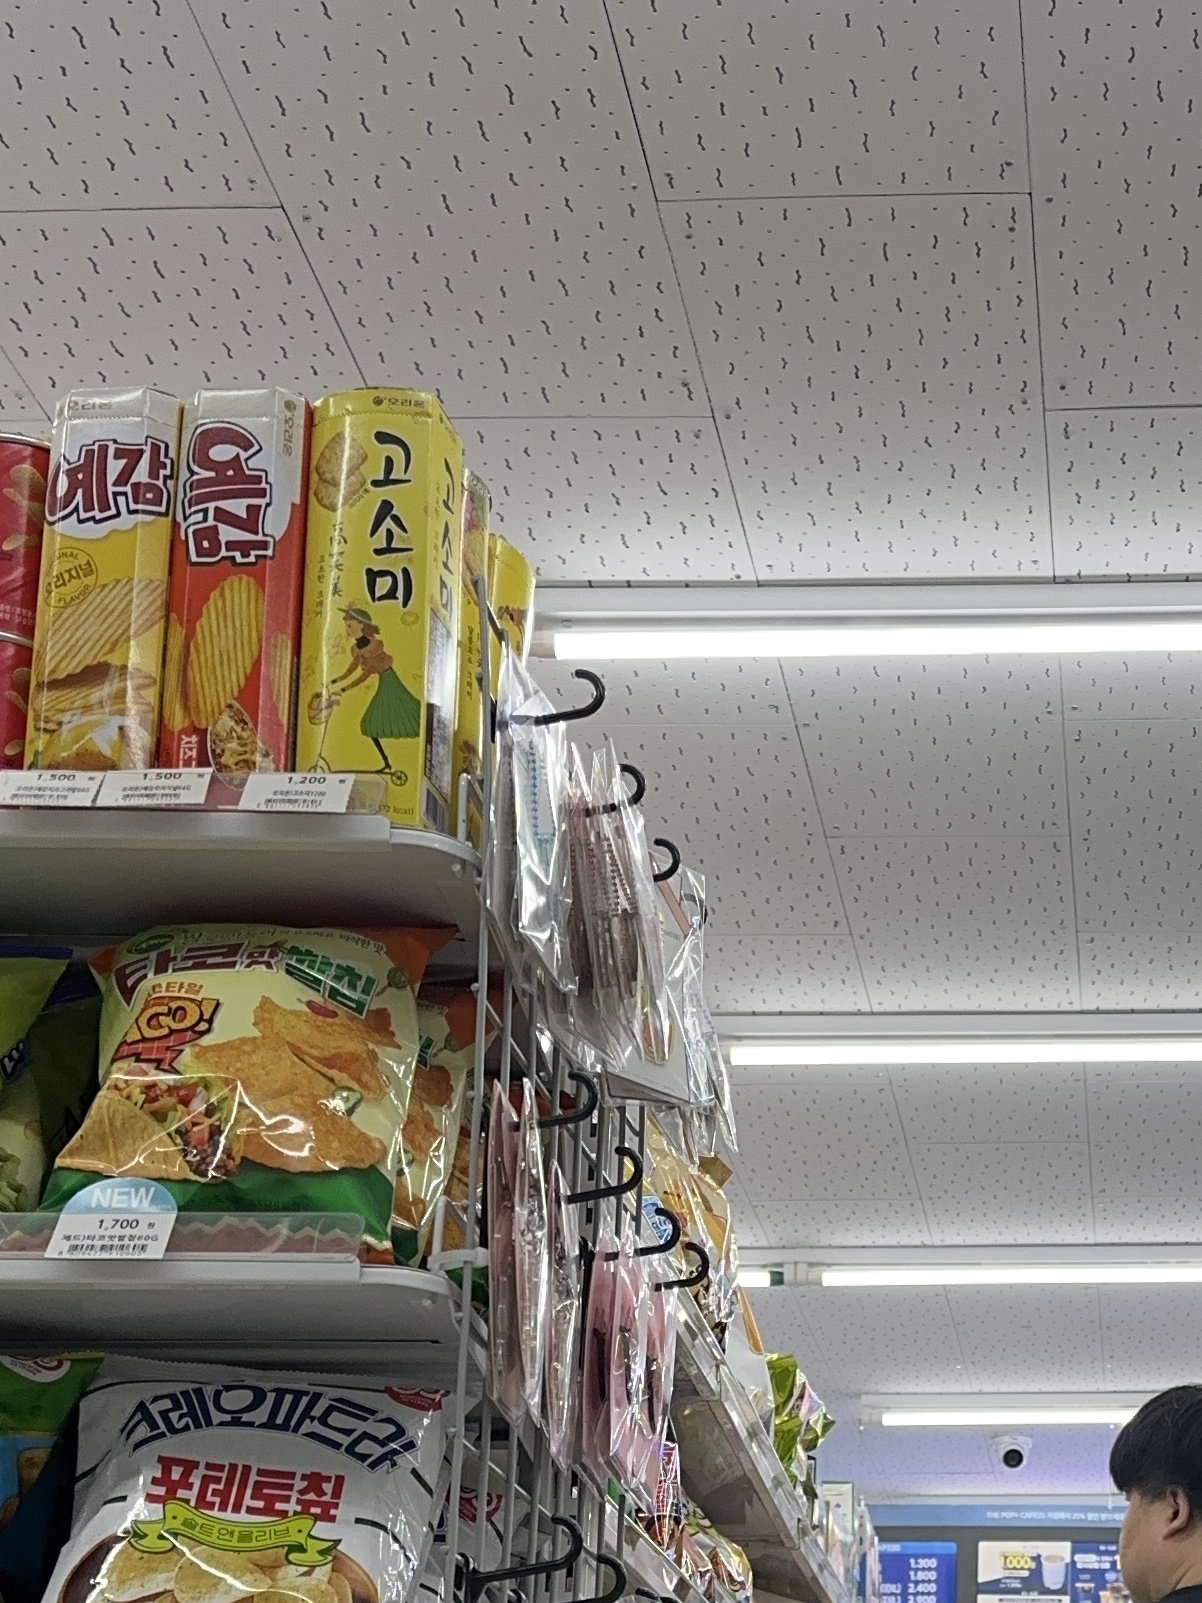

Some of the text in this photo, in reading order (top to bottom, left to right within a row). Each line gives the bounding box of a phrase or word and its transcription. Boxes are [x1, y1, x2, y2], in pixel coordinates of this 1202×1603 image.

[46, 438, 172, 523] 예감
[185, 423, 274, 563] 예감
[365, 430, 414, 609] 고소미
[37, 774, 76, 784] 1,500
[143, 773, 182, 783] 1,500
[287, 776, 327, 785] 1,200
[90, 1187, 156, 1209] NEW
[98, 1219, 140, 1231] 1,700
[121, 1384, 419, 1472] 크레오파트라
[180, 1517, 292, 1544] 솔트앤올리브
